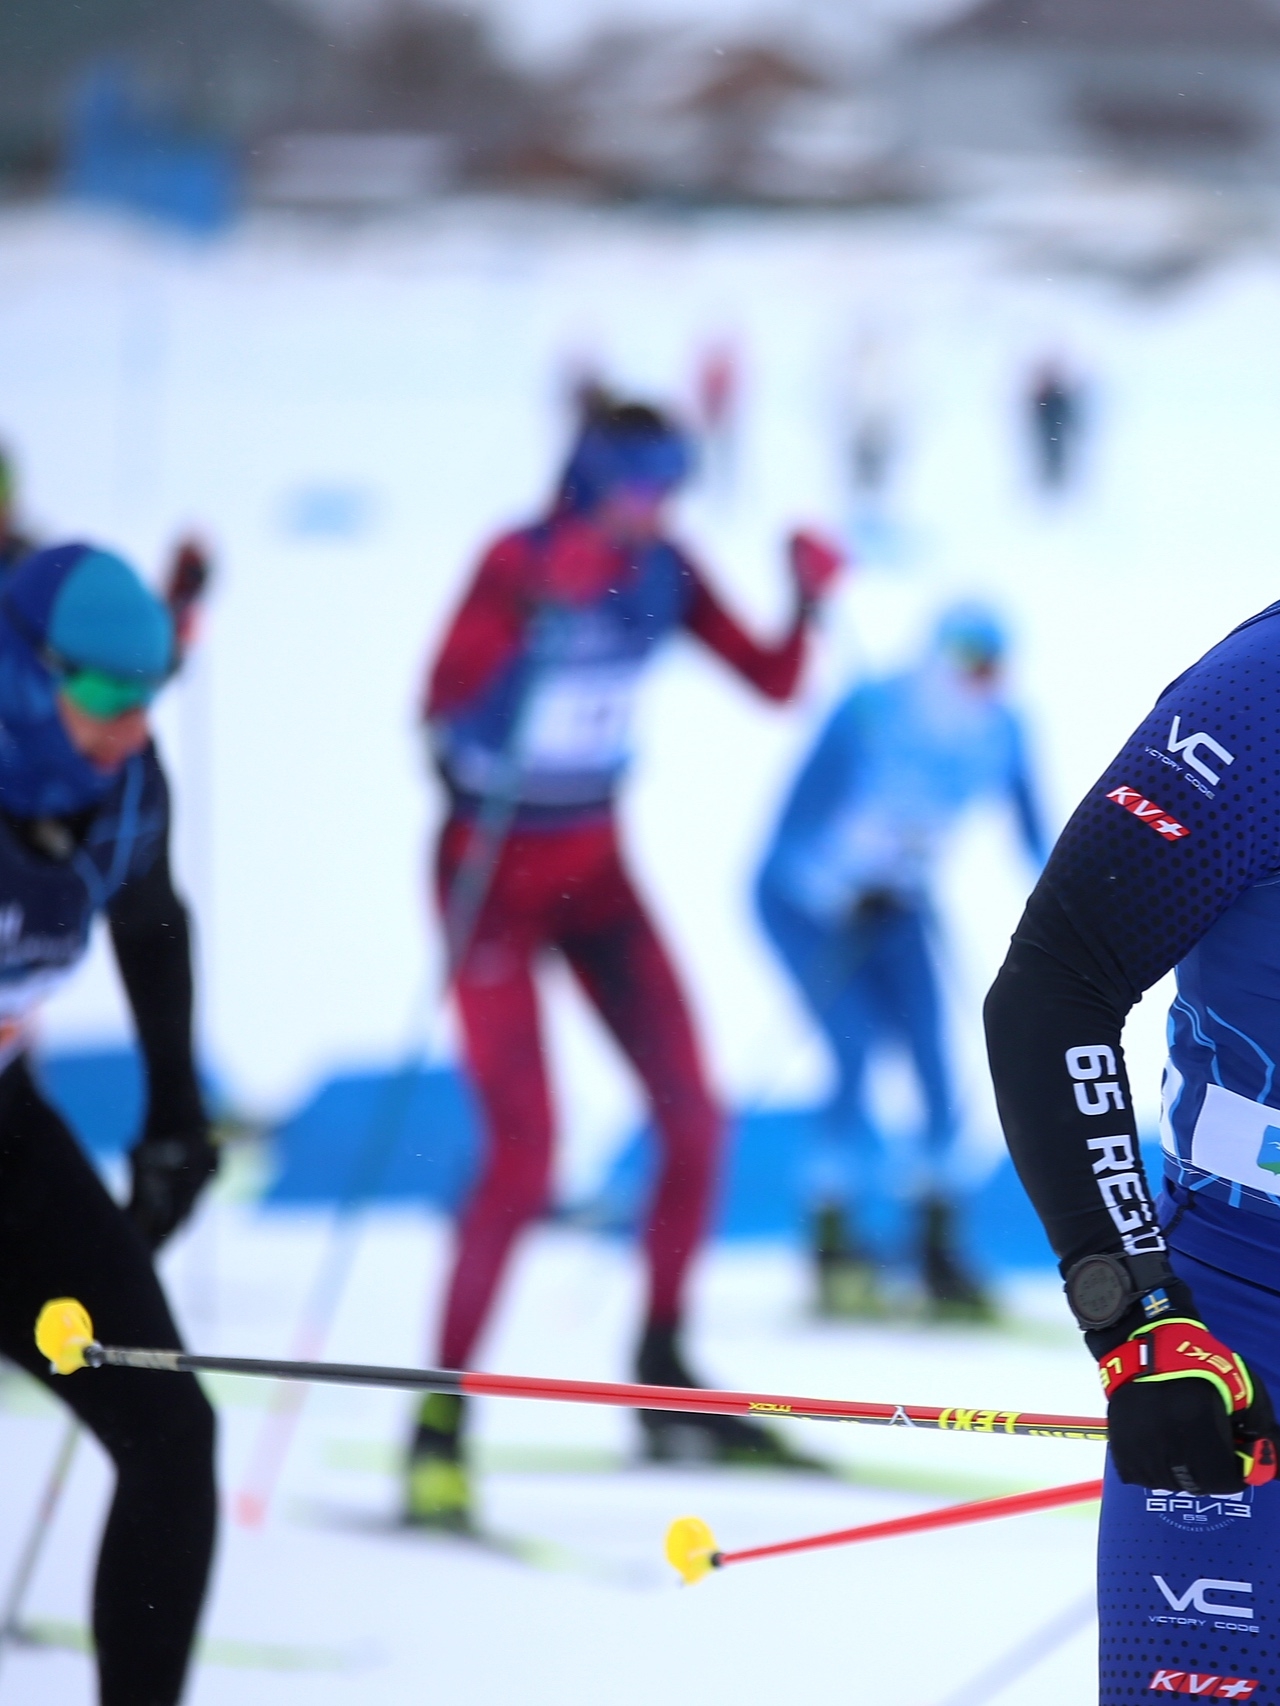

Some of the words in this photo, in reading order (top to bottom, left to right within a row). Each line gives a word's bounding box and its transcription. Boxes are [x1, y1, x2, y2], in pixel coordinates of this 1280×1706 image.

[1145, 746, 1183, 772] VICTORY
[1184, 773, 1215, 800] CODE
[1065, 1044, 1125, 1116] 65
[938, 1408, 1021, 1434] LEKI
[1146, 1498, 1252, 1518] БРИЗ
[1148, 1616, 1206, 1626] VICTORY
[1214, 1621, 1260, 1633] CODE
